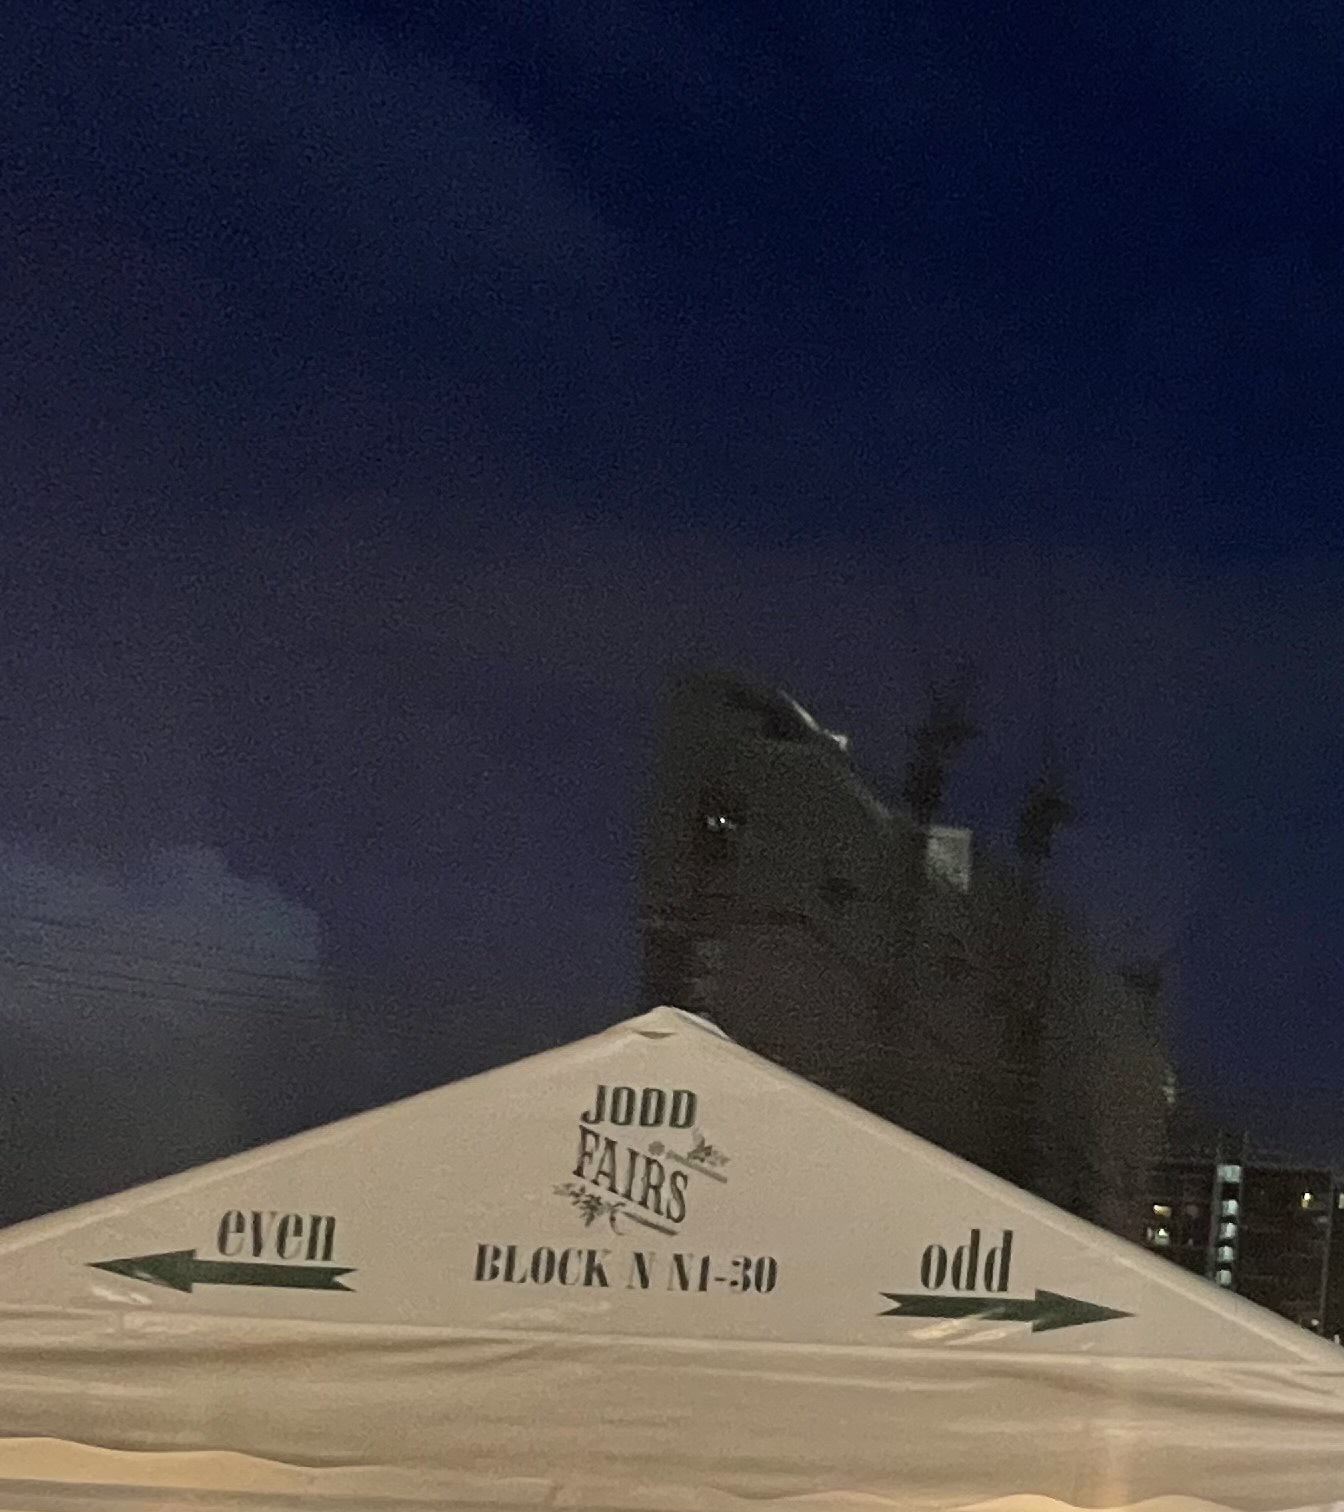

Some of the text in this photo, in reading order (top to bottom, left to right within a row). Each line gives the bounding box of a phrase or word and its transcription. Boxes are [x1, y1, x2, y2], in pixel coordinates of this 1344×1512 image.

[580, 1084, 697, 1129] JODD
[572, 1124, 688, 1224] FAIRS
[217, 1209, 336, 1261] even
[920, 1228, 1013, 1293] odd
[472, 1243, 778, 1294] BLOCK N N1-30
